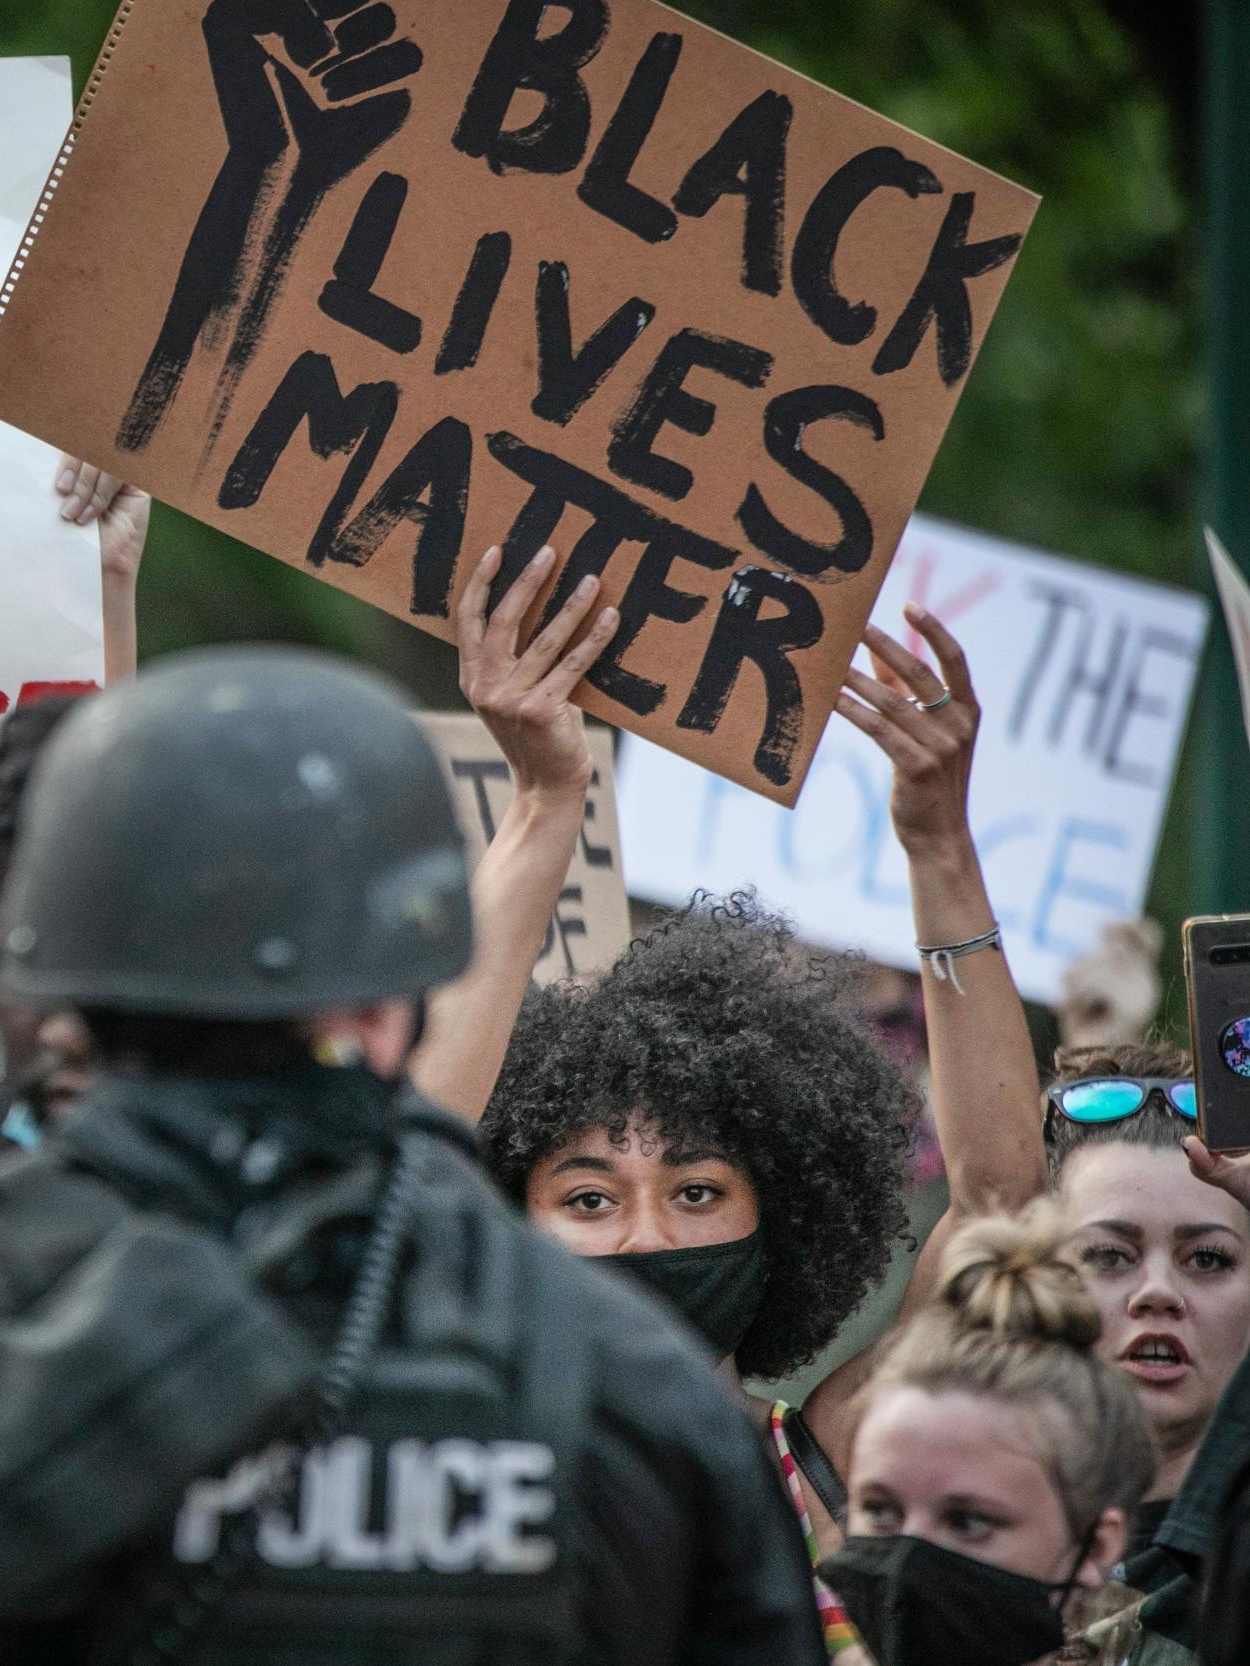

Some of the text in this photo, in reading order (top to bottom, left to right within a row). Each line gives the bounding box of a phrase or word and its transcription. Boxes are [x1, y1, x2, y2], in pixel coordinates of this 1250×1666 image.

[317, 171, 886, 578] LIVES
[451, 0, 1022, 388] BLACK
[215, 350, 824, 786] MATTER
[1006, 576, 1206, 788] THE
